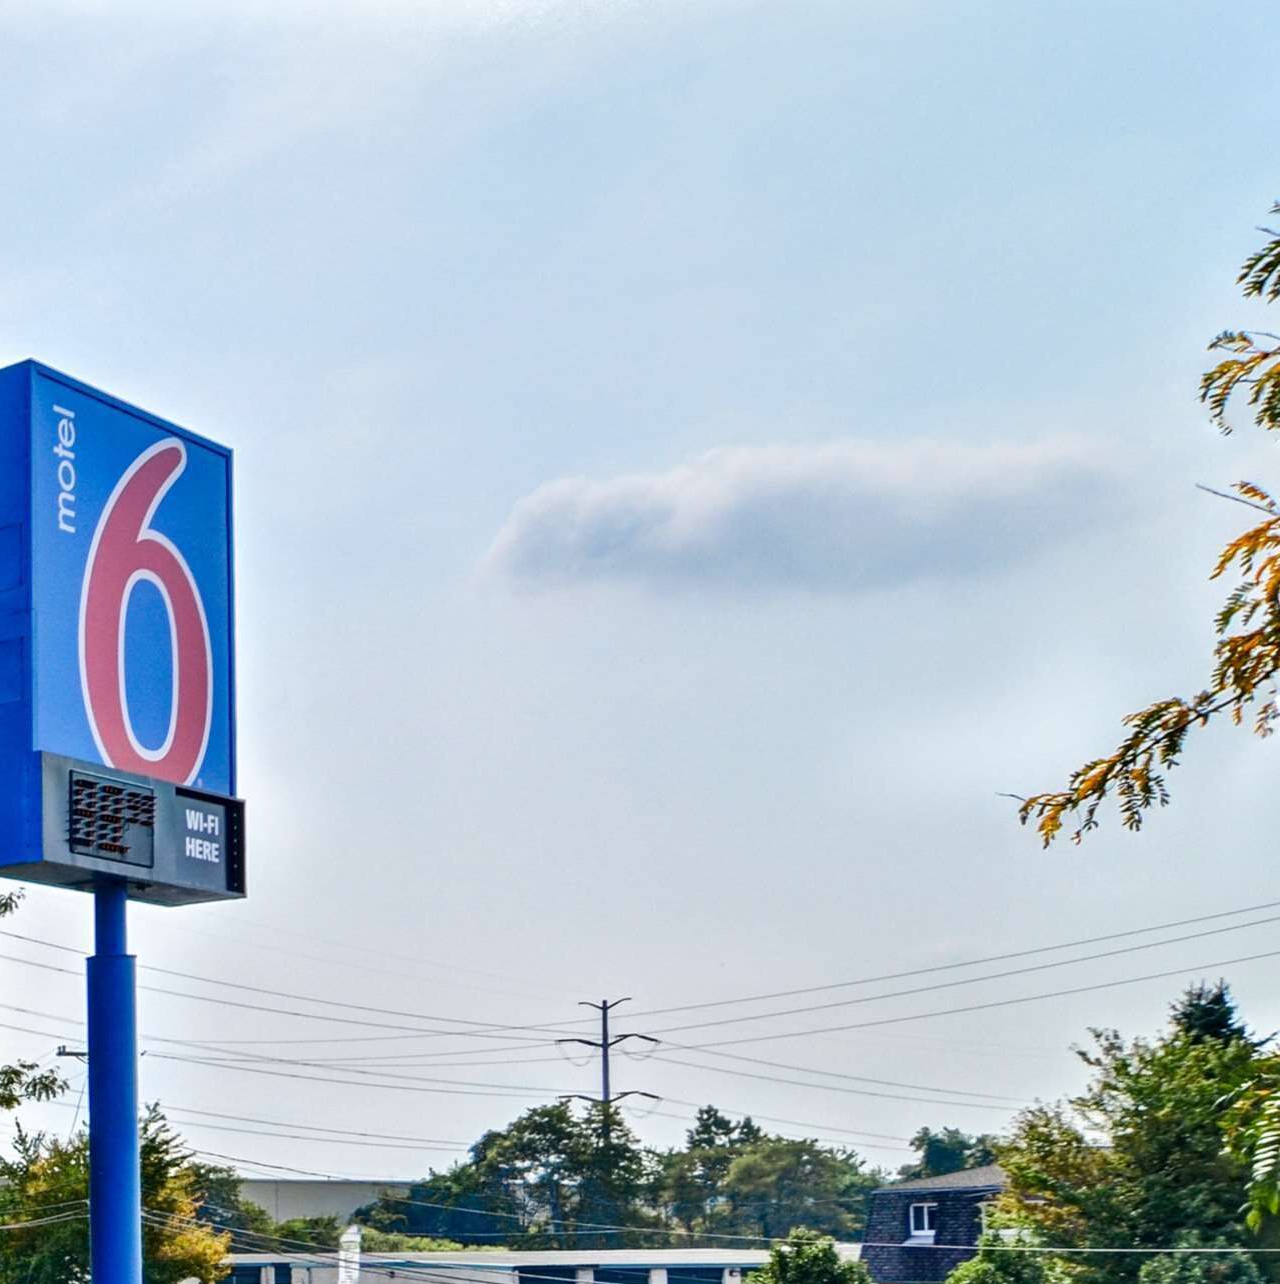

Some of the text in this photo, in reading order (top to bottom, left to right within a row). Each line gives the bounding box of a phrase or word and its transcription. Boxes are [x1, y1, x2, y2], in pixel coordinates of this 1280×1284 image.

[52, 404, 76, 533] motel
[78, 437, 213, 786] 6
[185, 808, 219, 836] WI-FI
[185, 836, 220, 863] HERE
